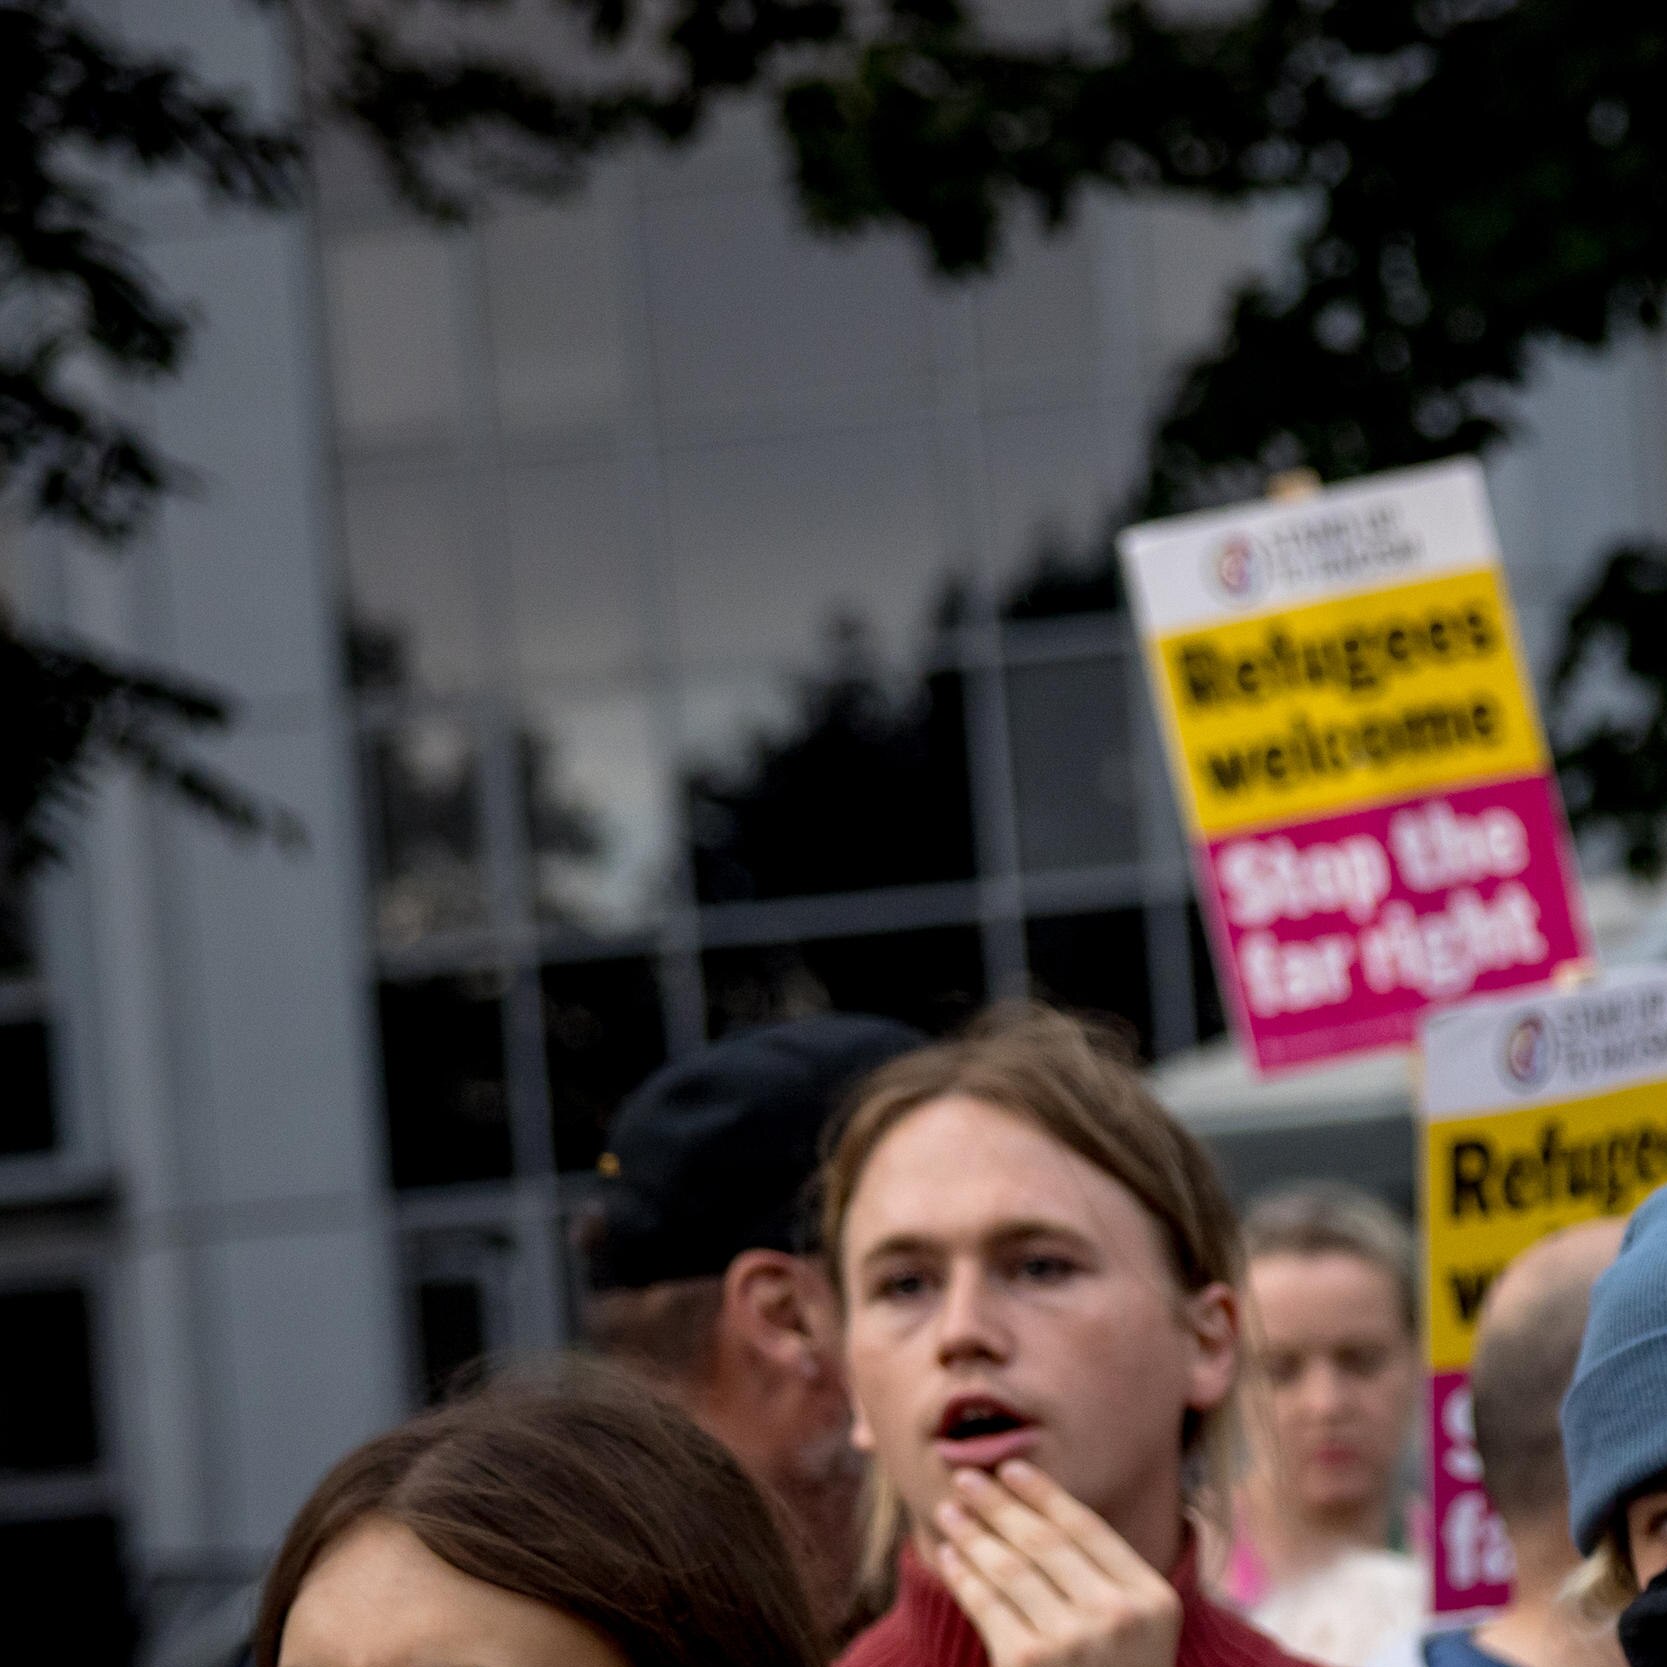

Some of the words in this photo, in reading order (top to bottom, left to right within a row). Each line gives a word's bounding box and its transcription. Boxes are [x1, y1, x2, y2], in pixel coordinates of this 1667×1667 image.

[1176, 604, 1498, 710] Refugees
[1204, 700, 1503, 797] welcome
[1215, 832, 1392, 928] Stop
[1388, 798, 1529, 892] the
[1236, 924, 1356, 1018] far
[1356, 882, 1550, 999] right
[1440, 1490, 1518, 1590] fa
